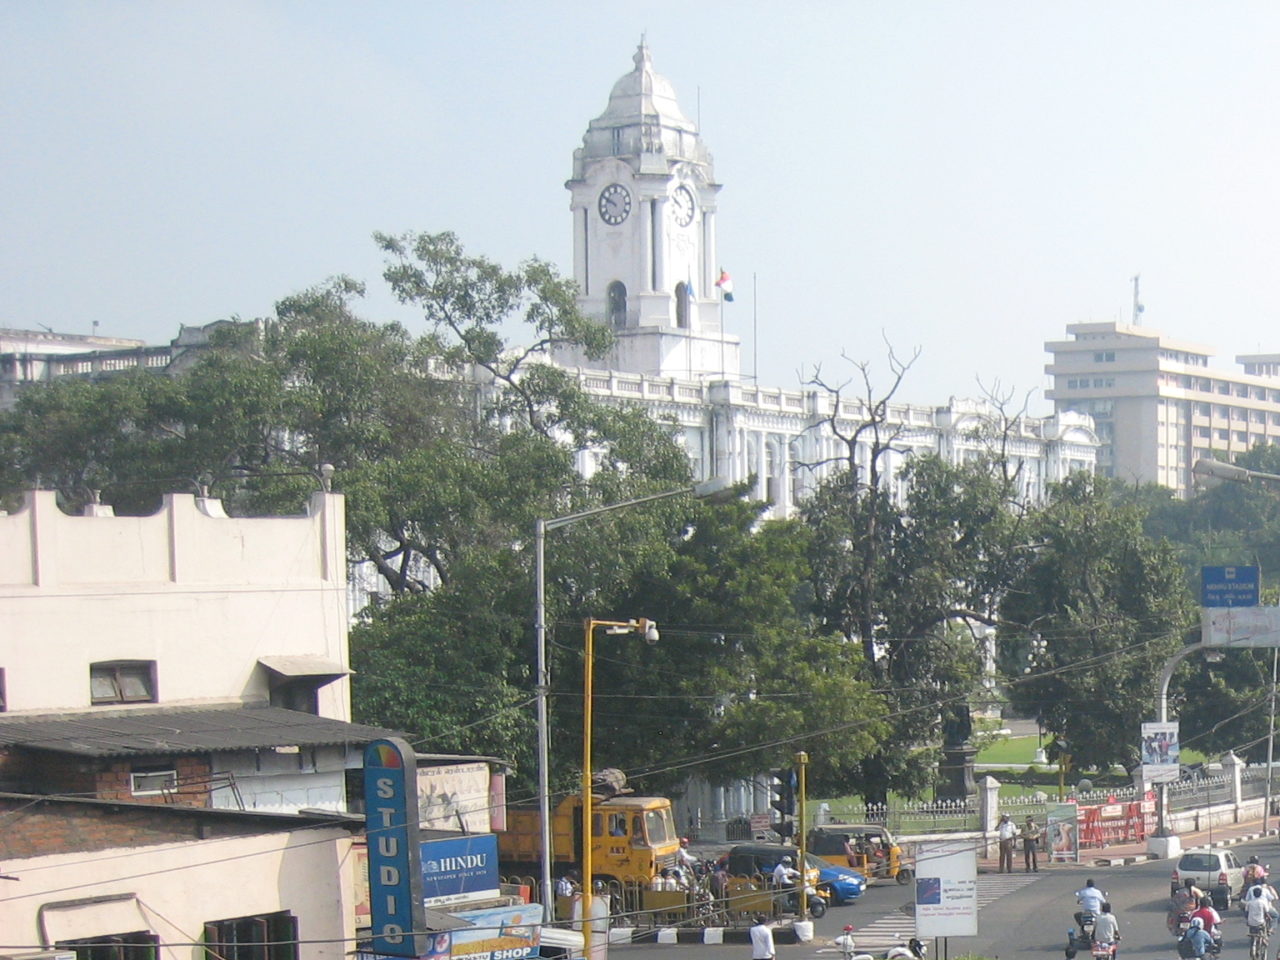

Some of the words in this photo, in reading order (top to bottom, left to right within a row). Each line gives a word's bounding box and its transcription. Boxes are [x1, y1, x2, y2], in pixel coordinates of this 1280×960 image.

[376, 778, 403, 944] STUDIO
[440, 853, 487, 872] HINDU
[493, 947, 531, 960] SHOP
